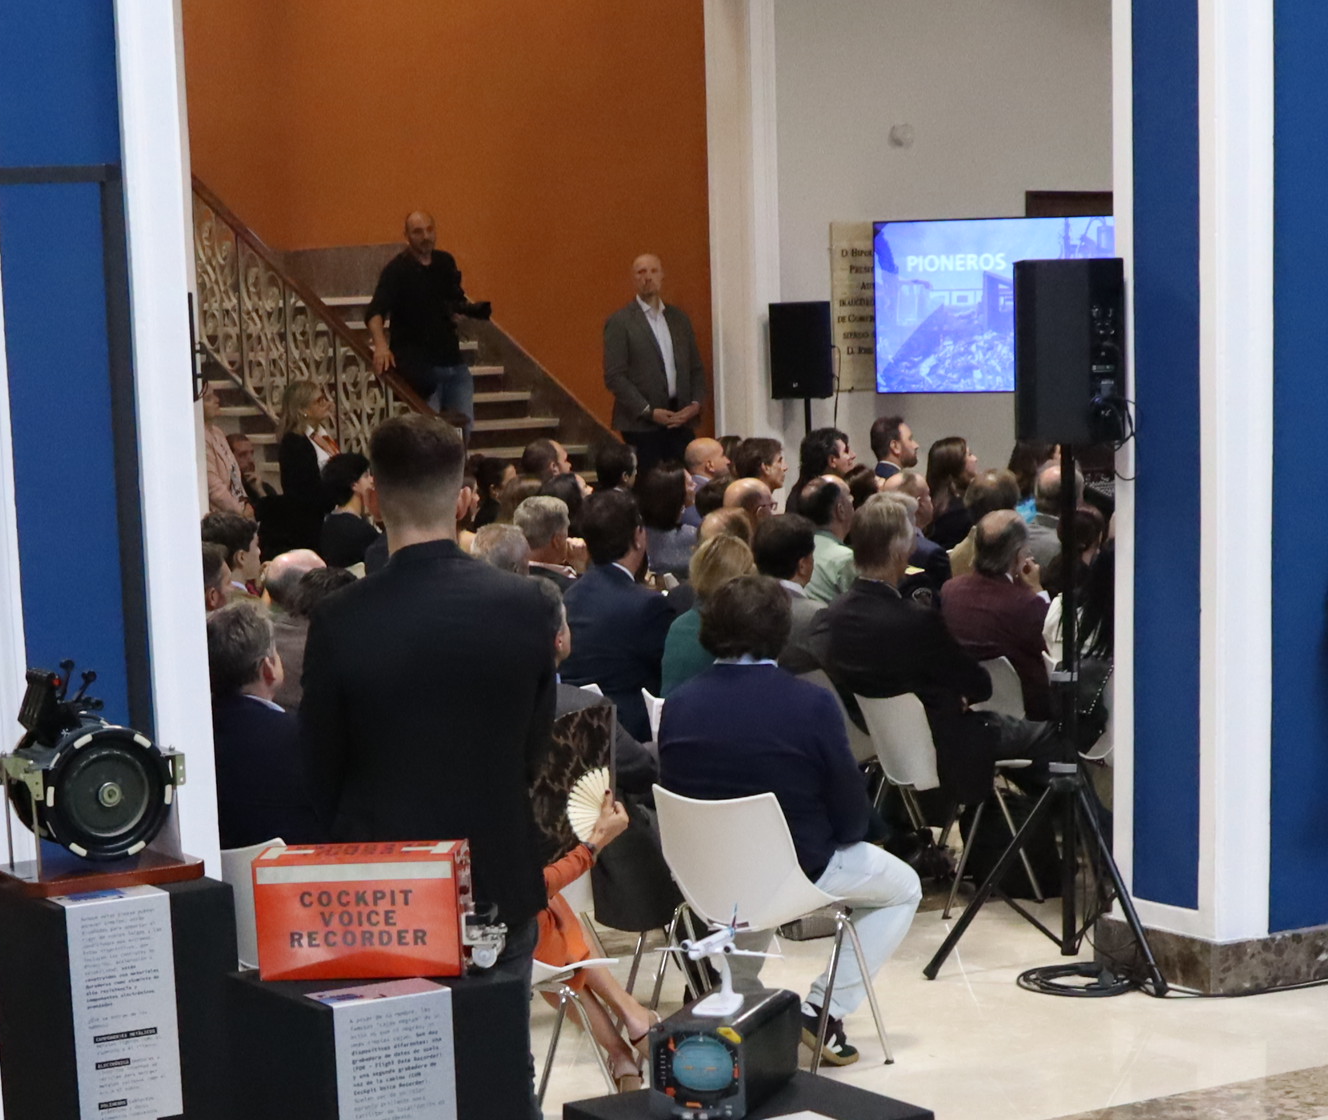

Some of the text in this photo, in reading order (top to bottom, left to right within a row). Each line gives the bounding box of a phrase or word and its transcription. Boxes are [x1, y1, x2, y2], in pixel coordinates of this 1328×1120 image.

[907, 252, 1006, 272] PIONEROS
[299, 888, 413, 909] COCKPIT
[320, 909, 398, 928] VOICE
[289, 928, 428, 949] RECORDER
